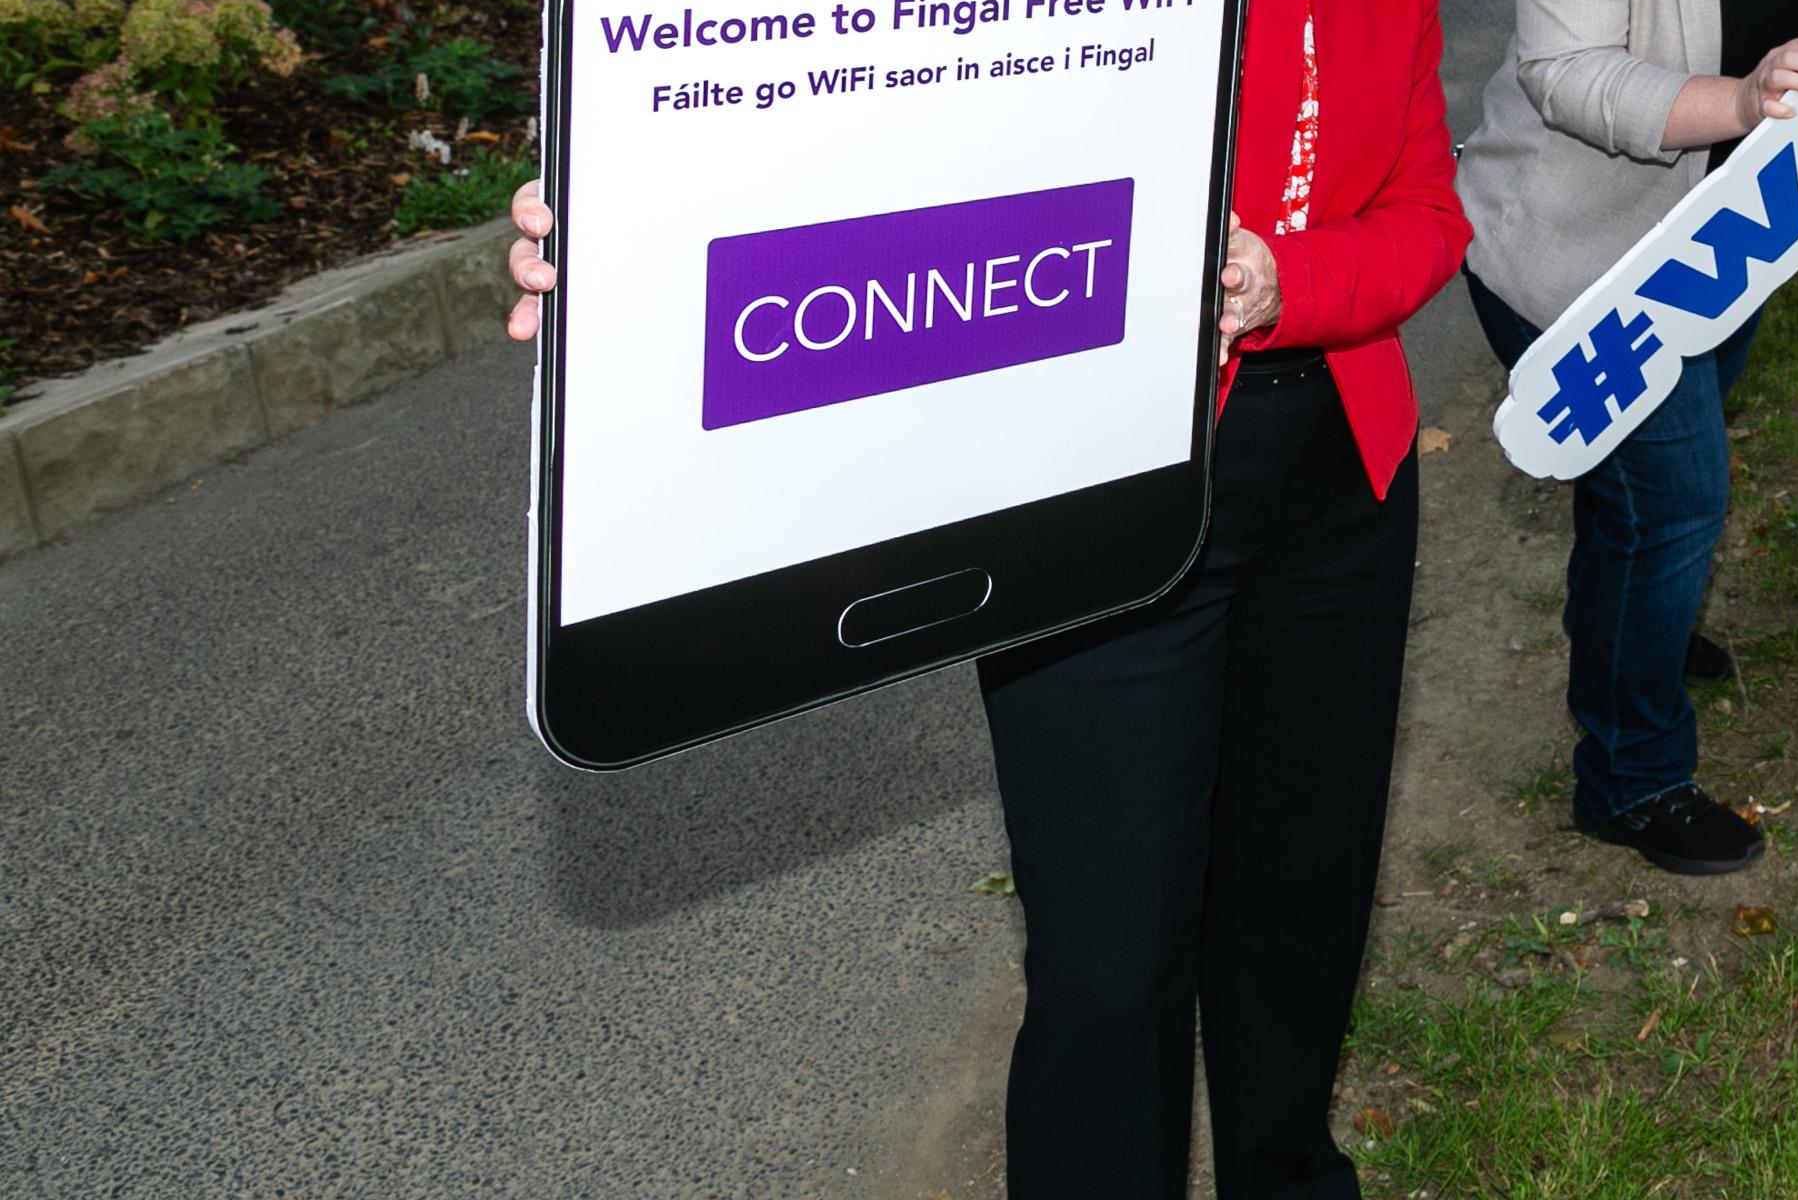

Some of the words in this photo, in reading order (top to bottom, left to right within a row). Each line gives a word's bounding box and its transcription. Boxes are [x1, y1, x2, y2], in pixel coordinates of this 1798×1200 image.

[600, 9, 815, 53] Welcome
[832, 4, 875, 34] to
[653, 80, 743, 112] Fáilte
[756, 81, 795, 109] go
[808, 65, 874, 95] WiFi
[885, 66, 947, 88] saor
[957, 57, 979, 80] in
[990, 53, 1054, 77] aisce
[1065, 47, 1070, 69] i
[1081, 38, 1154, 71] Fingal
[733, 238, 1112, 362] CONNECT
